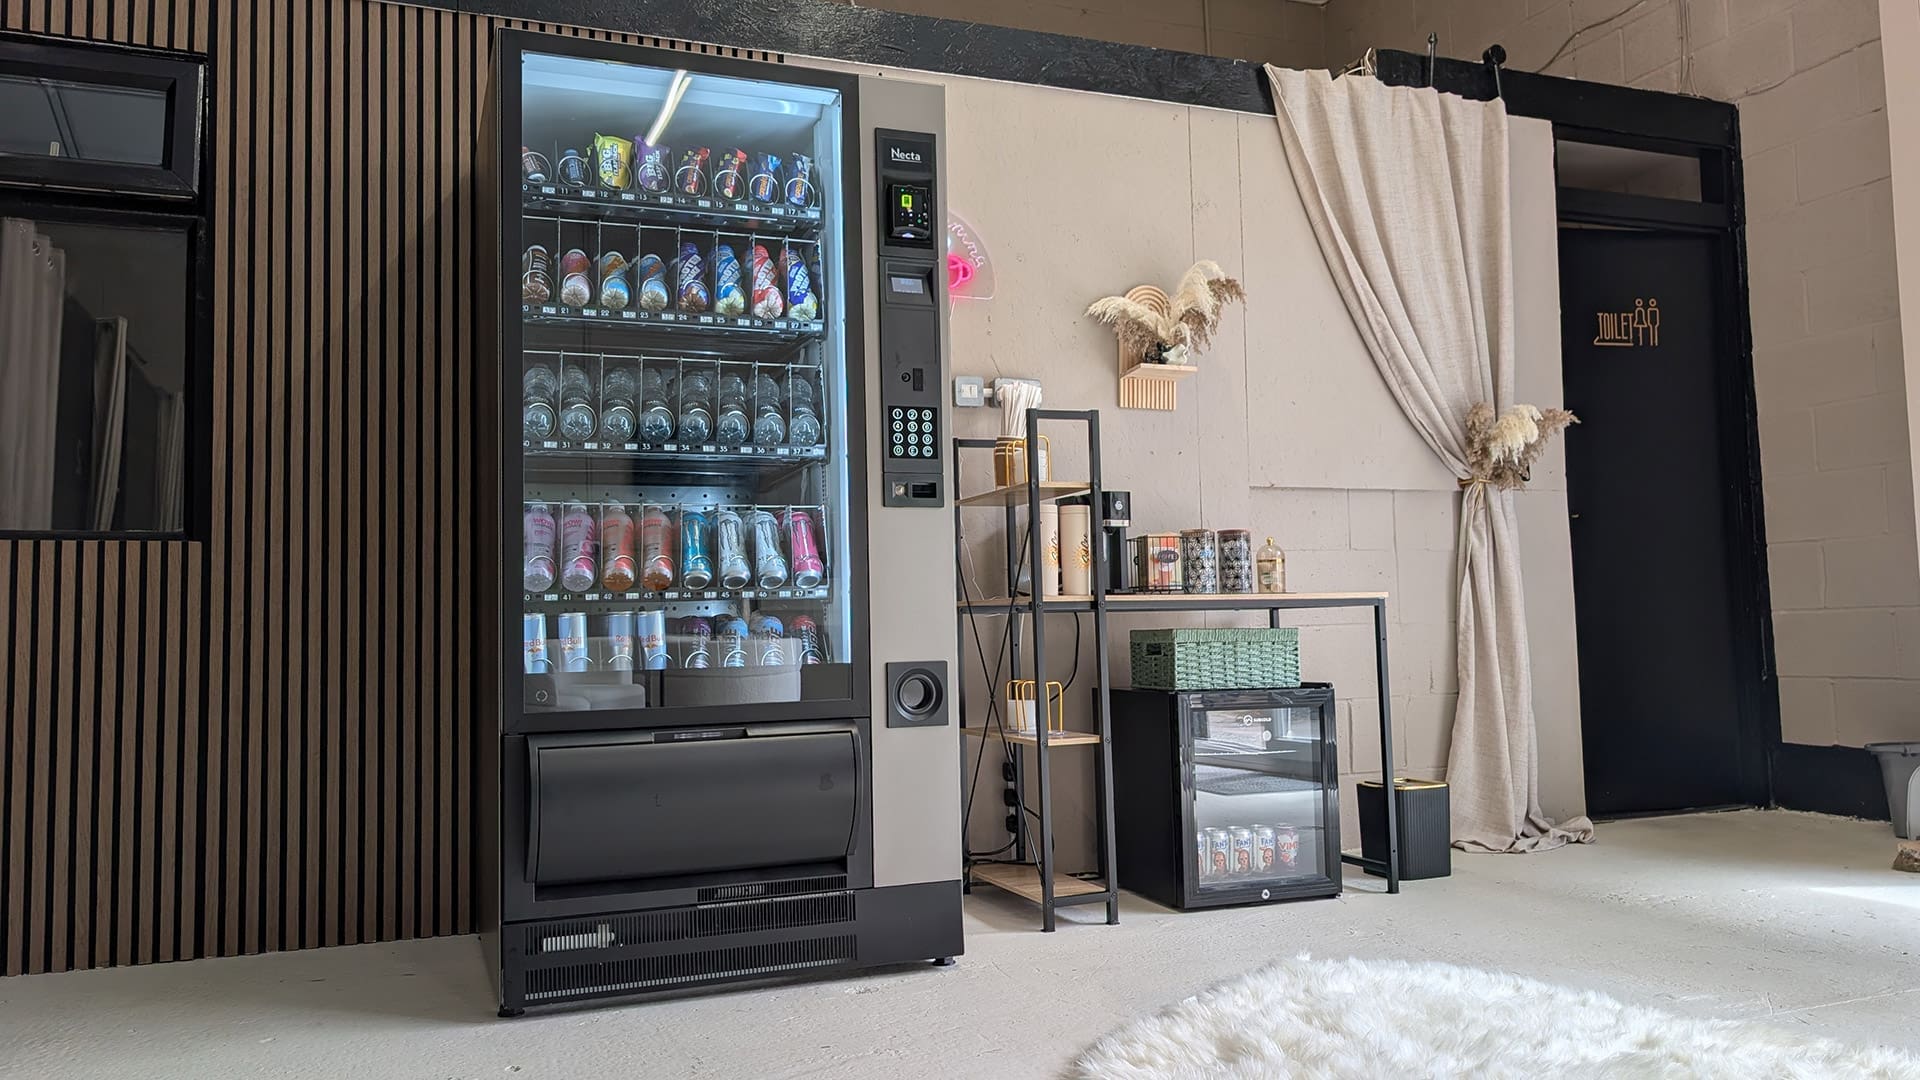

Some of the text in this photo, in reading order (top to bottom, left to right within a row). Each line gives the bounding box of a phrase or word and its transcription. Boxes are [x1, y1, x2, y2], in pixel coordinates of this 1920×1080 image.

[602, 147, 613, 172] BIG
[645, 153, 656, 178] BIG
[891, 147, 921, 161] Necta
[1597, 312, 1634, 341] TOILET
